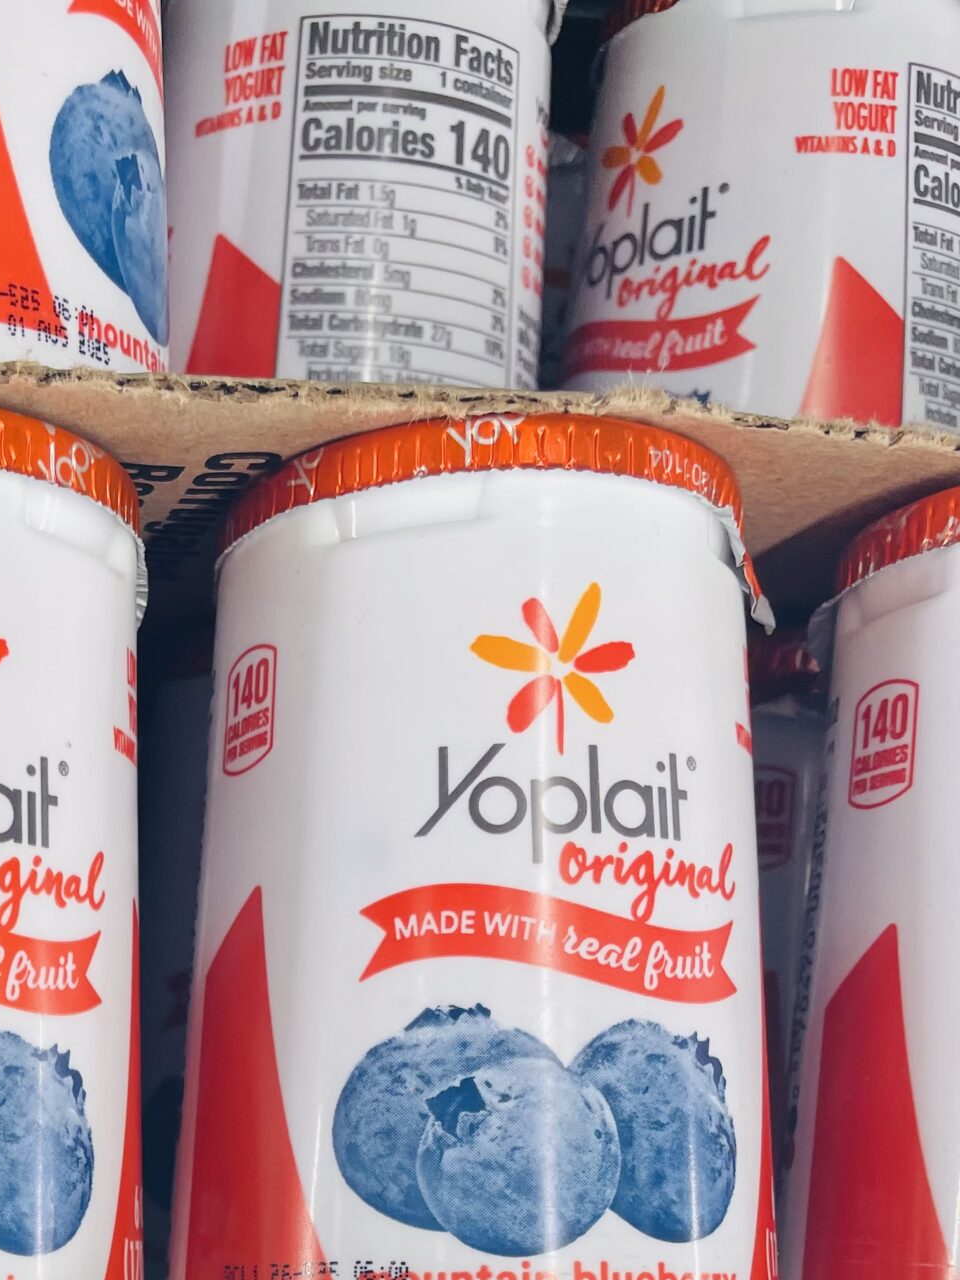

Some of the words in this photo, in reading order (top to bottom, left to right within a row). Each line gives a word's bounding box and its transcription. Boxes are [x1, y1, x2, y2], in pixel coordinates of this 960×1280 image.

[224, 37, 257, 73] LOW
[259, 31, 288, 64] FAT
[308, 22, 440, 63] Nutrition
[454, 34, 514, 87] Facts
[224, 65, 285, 106] YOGURT
[305, 61, 374, 84] Serving
[378, 64, 413, 83] size
[440, 71, 447, 88] 1
[830, 67, 869, 98] LOW
[872, 69, 900, 101] FAT
[832, 101, 898, 135] YOGURT
[913, 108, 960, 142] Serving
[301, 117, 436, 159] Calories
[449, 120, 511, 182] 140
[795, 134, 858, 155] VITAMINS
[860, 138, 870, 155] A
[872, 138, 883, 156] &
[886, 139, 897, 158] D
[297, 182, 332, 201] Total
[336, 182, 360, 201] Fat
[306, 208, 370, 229] Saturated
[306, 234, 340, 254] Trans
[344, 235, 366, 255] Fat
[292, 261, 375, 281] Cholesterol
[615, 234, 772, 320] original
[657, 317, 728, 370] fruit
[231, 657, 270, 718] 140
[227, 706, 270, 745] CALORIES
[860, 692, 910, 751] 140
[853, 743, 909, 777] CALORIES
[413, 742, 689, 865] Yoplait
[558, 840, 736, 922] original
[393, 910, 476, 941] MADE
[482, 910, 556, 946] WITH
[561, 925, 642, 973] real
[643, 940, 715, 990] fruit
[4, 943, 80, 1002] fruit
